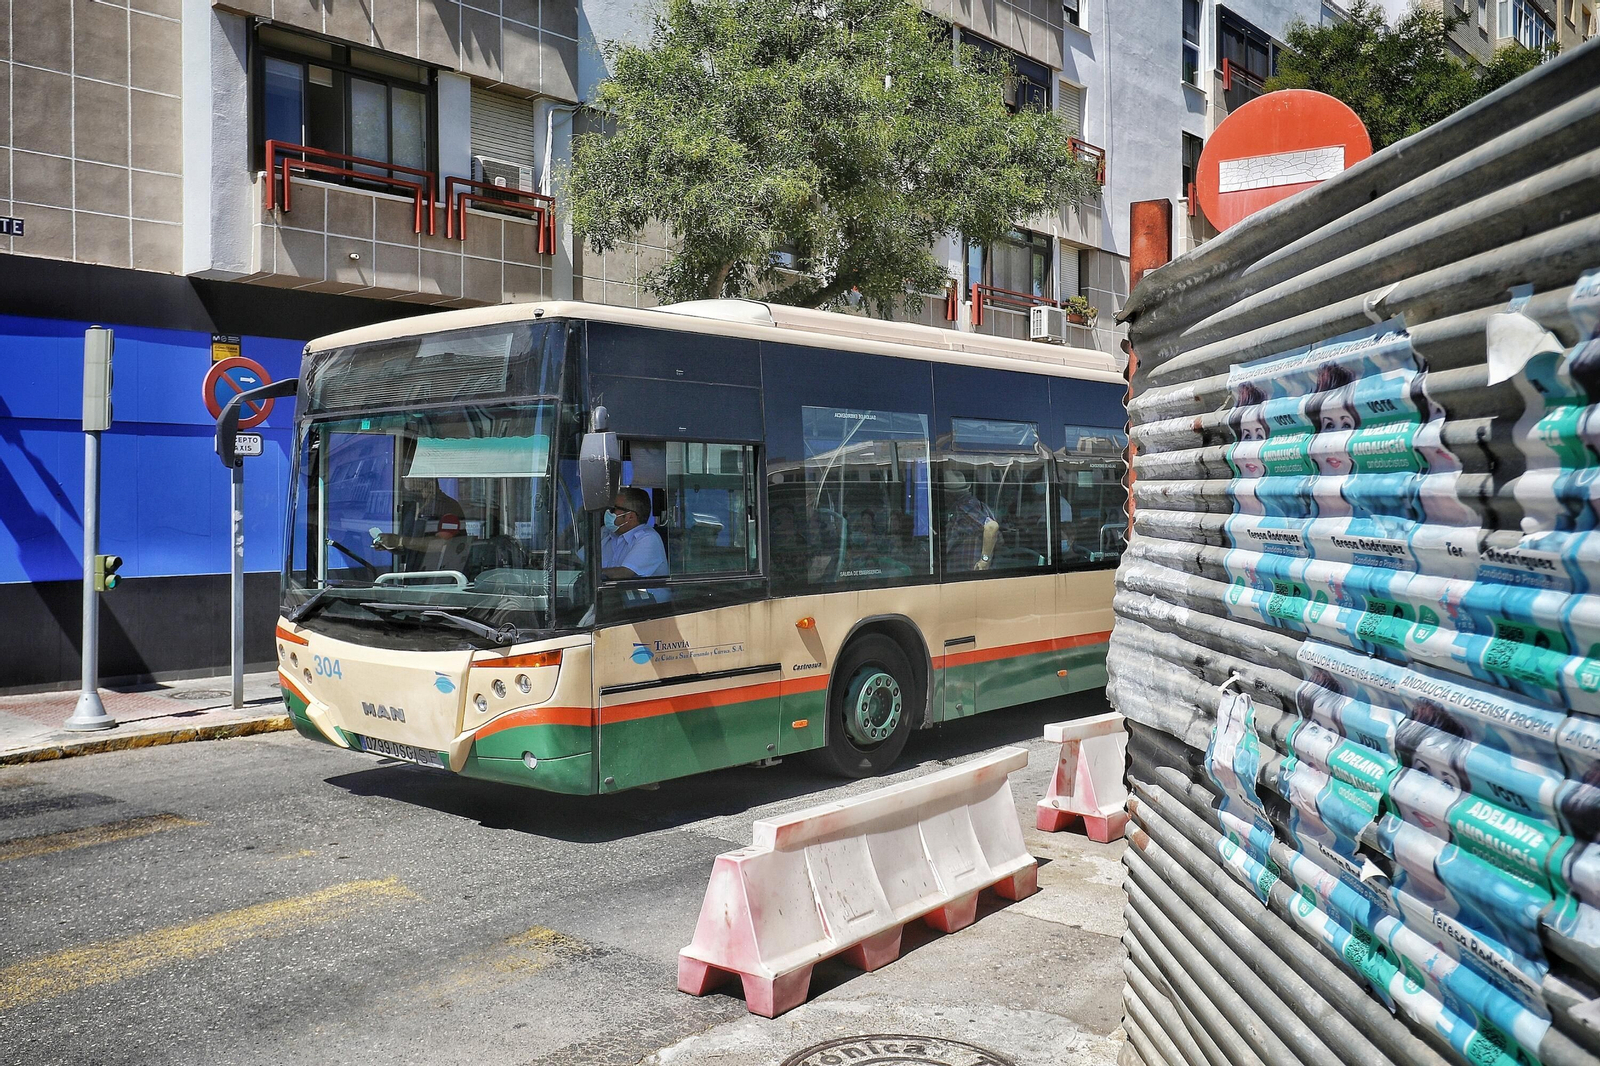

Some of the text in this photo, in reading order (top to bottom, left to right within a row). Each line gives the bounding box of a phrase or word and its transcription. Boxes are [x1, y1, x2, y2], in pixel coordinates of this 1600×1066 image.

[1366, 398, 1398, 414] VOTA
[1274, 413, 1297, 426] VOTA
[1360, 419, 1411, 437] ADELANTE
[1270, 431, 1306, 446] ADELANTE
[1352, 435, 1408, 456] ANDALUCÍA
[1263, 445, 1301, 462] ANDALUCÍA
[1247, 529, 1301, 545] Teresa Rodríguez
[1330, 536, 1406, 556] Teresa Rodríguez
[1445, 541, 1464, 558] Ter
[1486, 548, 1557, 571] Rodríguez
[313, 654, 343, 681] 304
[1299, 648, 1397, 691] ANDALUCÍA EN DEFENSA PROPIA
[361, 701, 406, 724] MAN
[1401, 675, 1554, 735] ANDALUCÍA EN DEFENSA PROPIA
[365, 736, 392, 756] 0799
[393, 746, 415, 760] DSG
[1337, 749, 1386, 781] ADELANTE
[1486, 781, 1532, 812] VOTA
[1465, 800, 1546, 849] ADELANTE
[1456, 818, 1544, 876] ANDALUCÍA
[1431, 907, 1468, 949] Teresa
